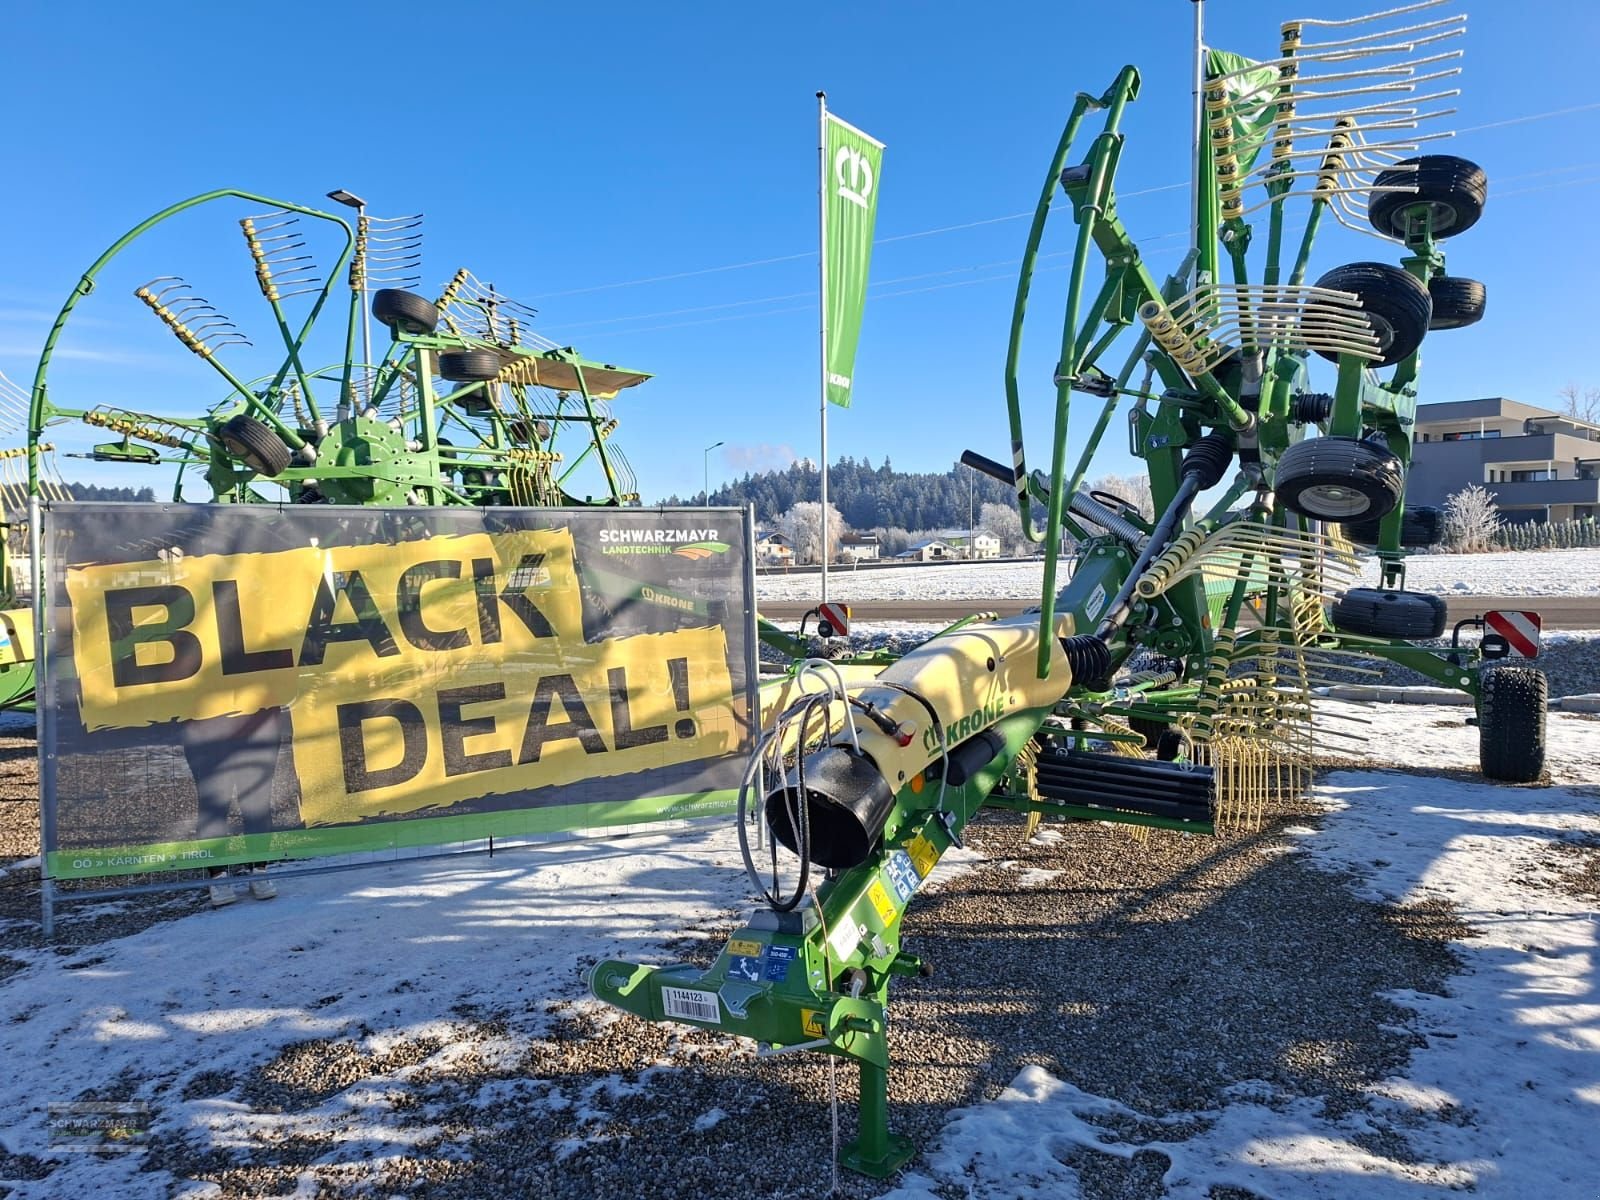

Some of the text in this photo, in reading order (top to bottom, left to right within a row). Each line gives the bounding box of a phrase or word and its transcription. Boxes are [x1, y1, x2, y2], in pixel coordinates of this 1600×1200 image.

[599, 529, 719, 543] SCHWARZMAYR
[602, 545, 673, 554] LANDTECHNIK
[655, 593, 695, 610] KRONE
[104, 553, 558, 688] BLACK
[336, 656, 697, 794] DEAL!
[945, 696, 1005, 746] KRONE
[656, 799, 738, 814] www.schwarzmayr.a
[72, 858, 92, 869] OÖ
[181, 850, 214, 861] TIROL
[673, 990, 703, 1002] 1144123
